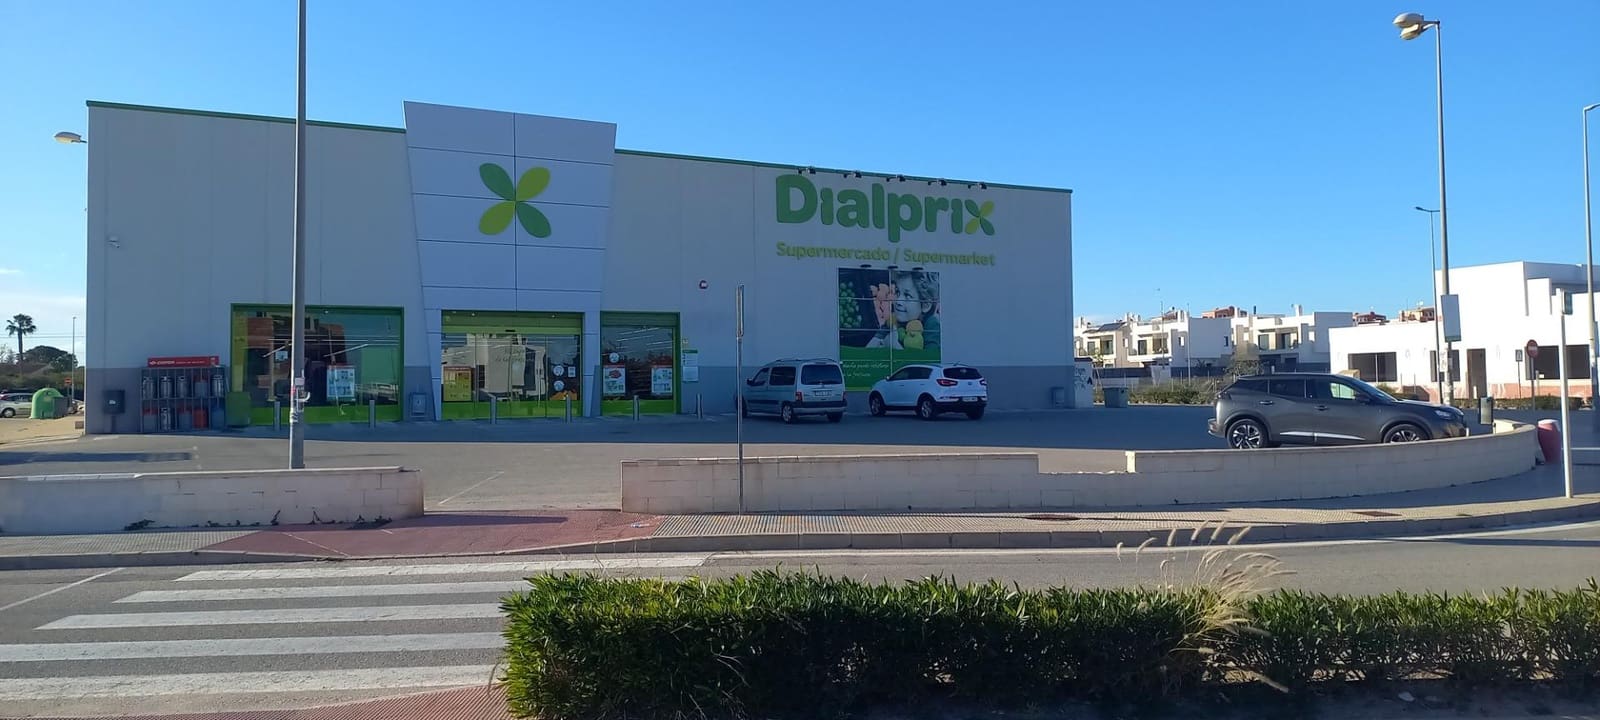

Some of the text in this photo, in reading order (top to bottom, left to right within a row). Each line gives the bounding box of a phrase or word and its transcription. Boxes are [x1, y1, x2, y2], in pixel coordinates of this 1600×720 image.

[776, 174, 995, 243] Dialprix
[776, 241, 890, 261] Supermercado
[903, 249, 995, 266] Supermarket
